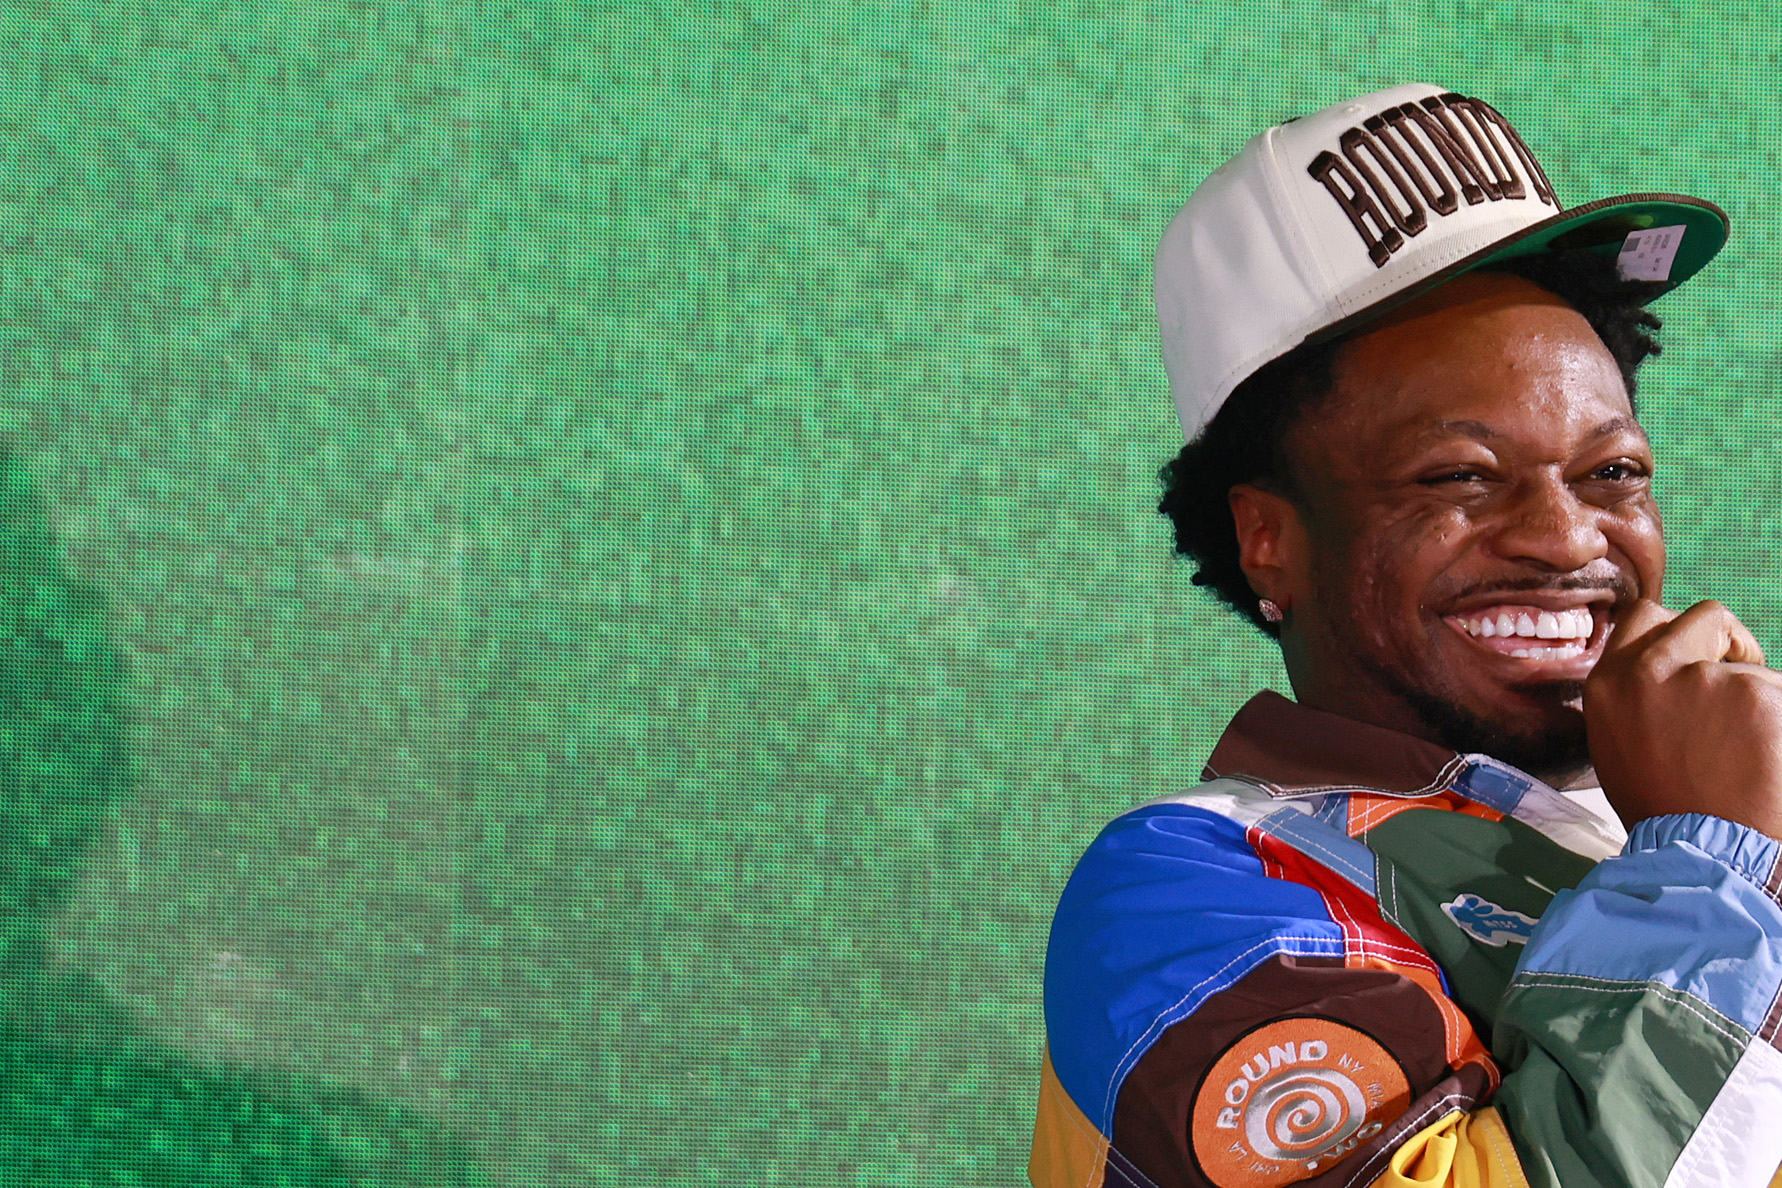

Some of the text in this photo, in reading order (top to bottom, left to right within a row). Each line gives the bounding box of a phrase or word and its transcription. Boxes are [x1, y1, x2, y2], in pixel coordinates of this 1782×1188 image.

[1307, 92, 1527, 268] ROUND
[1216, 1039, 1329, 1130] ROUND
[1338, 1052, 1366, 1074] NY
[1228, 1140, 1249, 1162] LA
[1299, 1120, 1383, 1171] TWO
